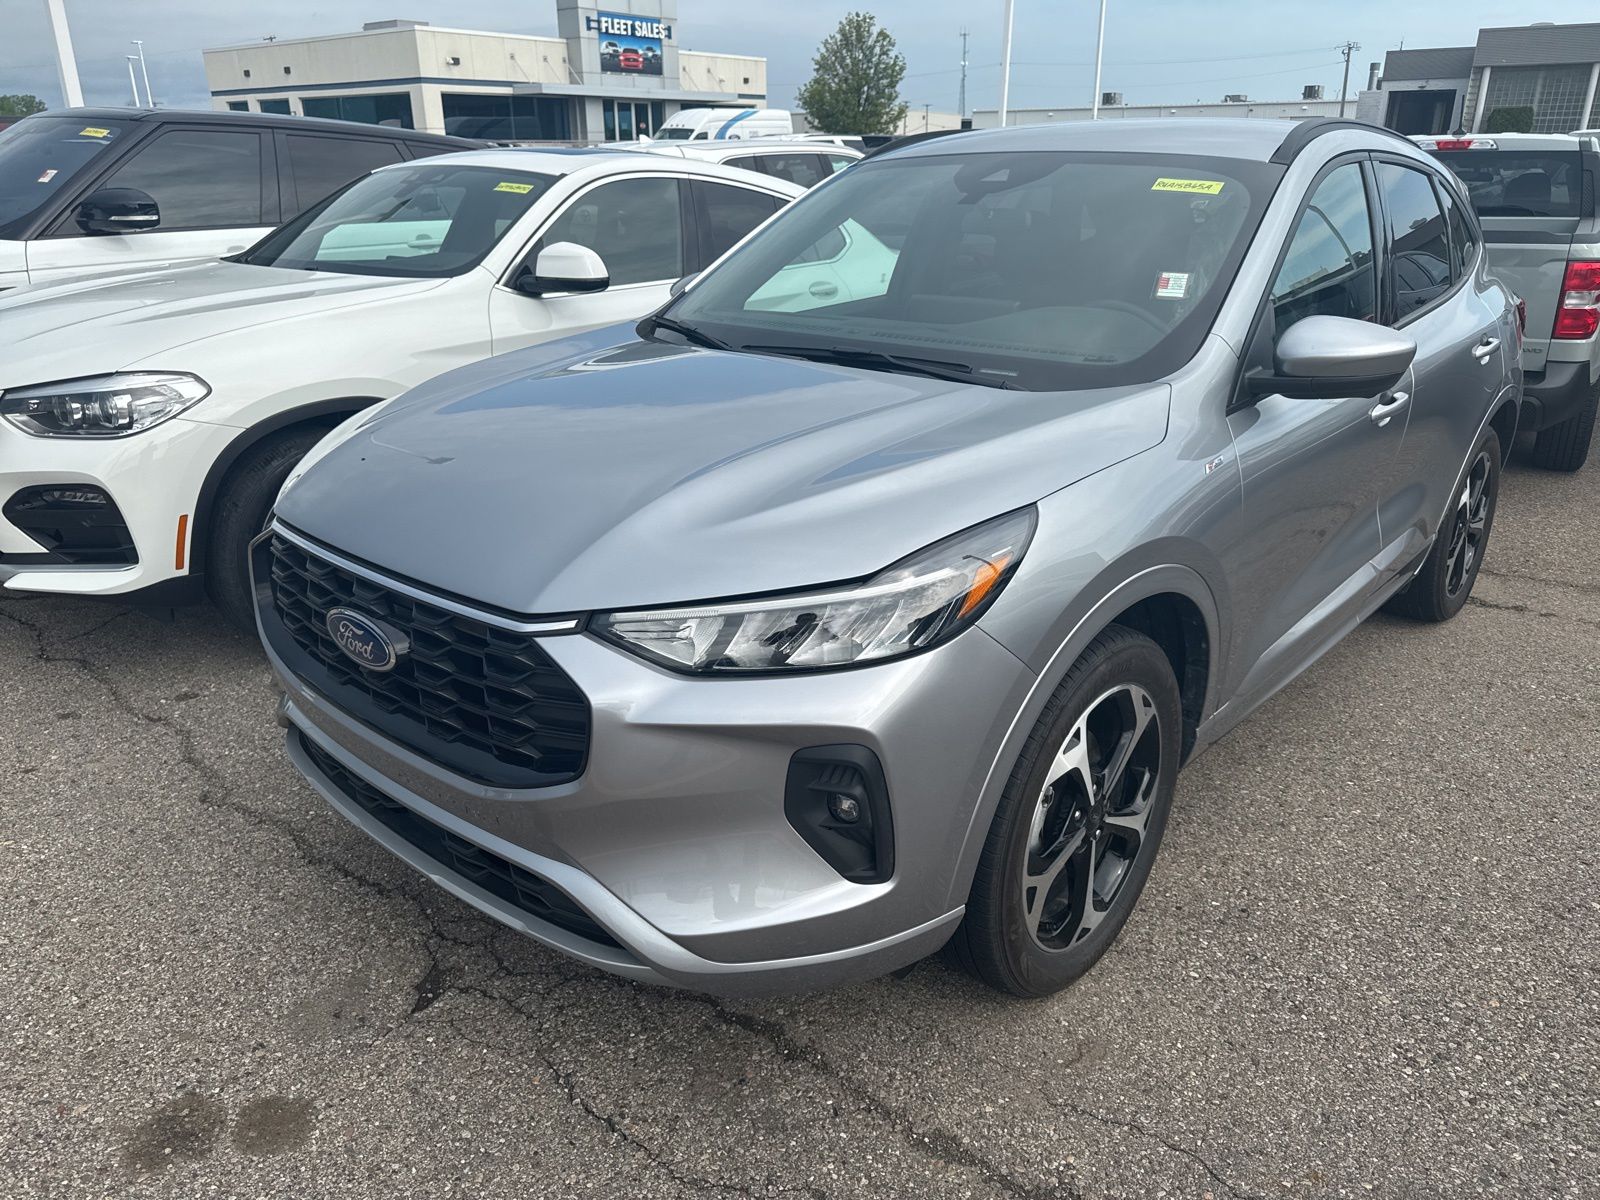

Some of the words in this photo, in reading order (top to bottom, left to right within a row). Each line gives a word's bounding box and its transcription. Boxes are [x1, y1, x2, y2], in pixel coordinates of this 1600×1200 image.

[600, 17, 632, 36] FLEET
[634, 21, 666, 39] SALES
[337, 620, 374, 660] Ford
